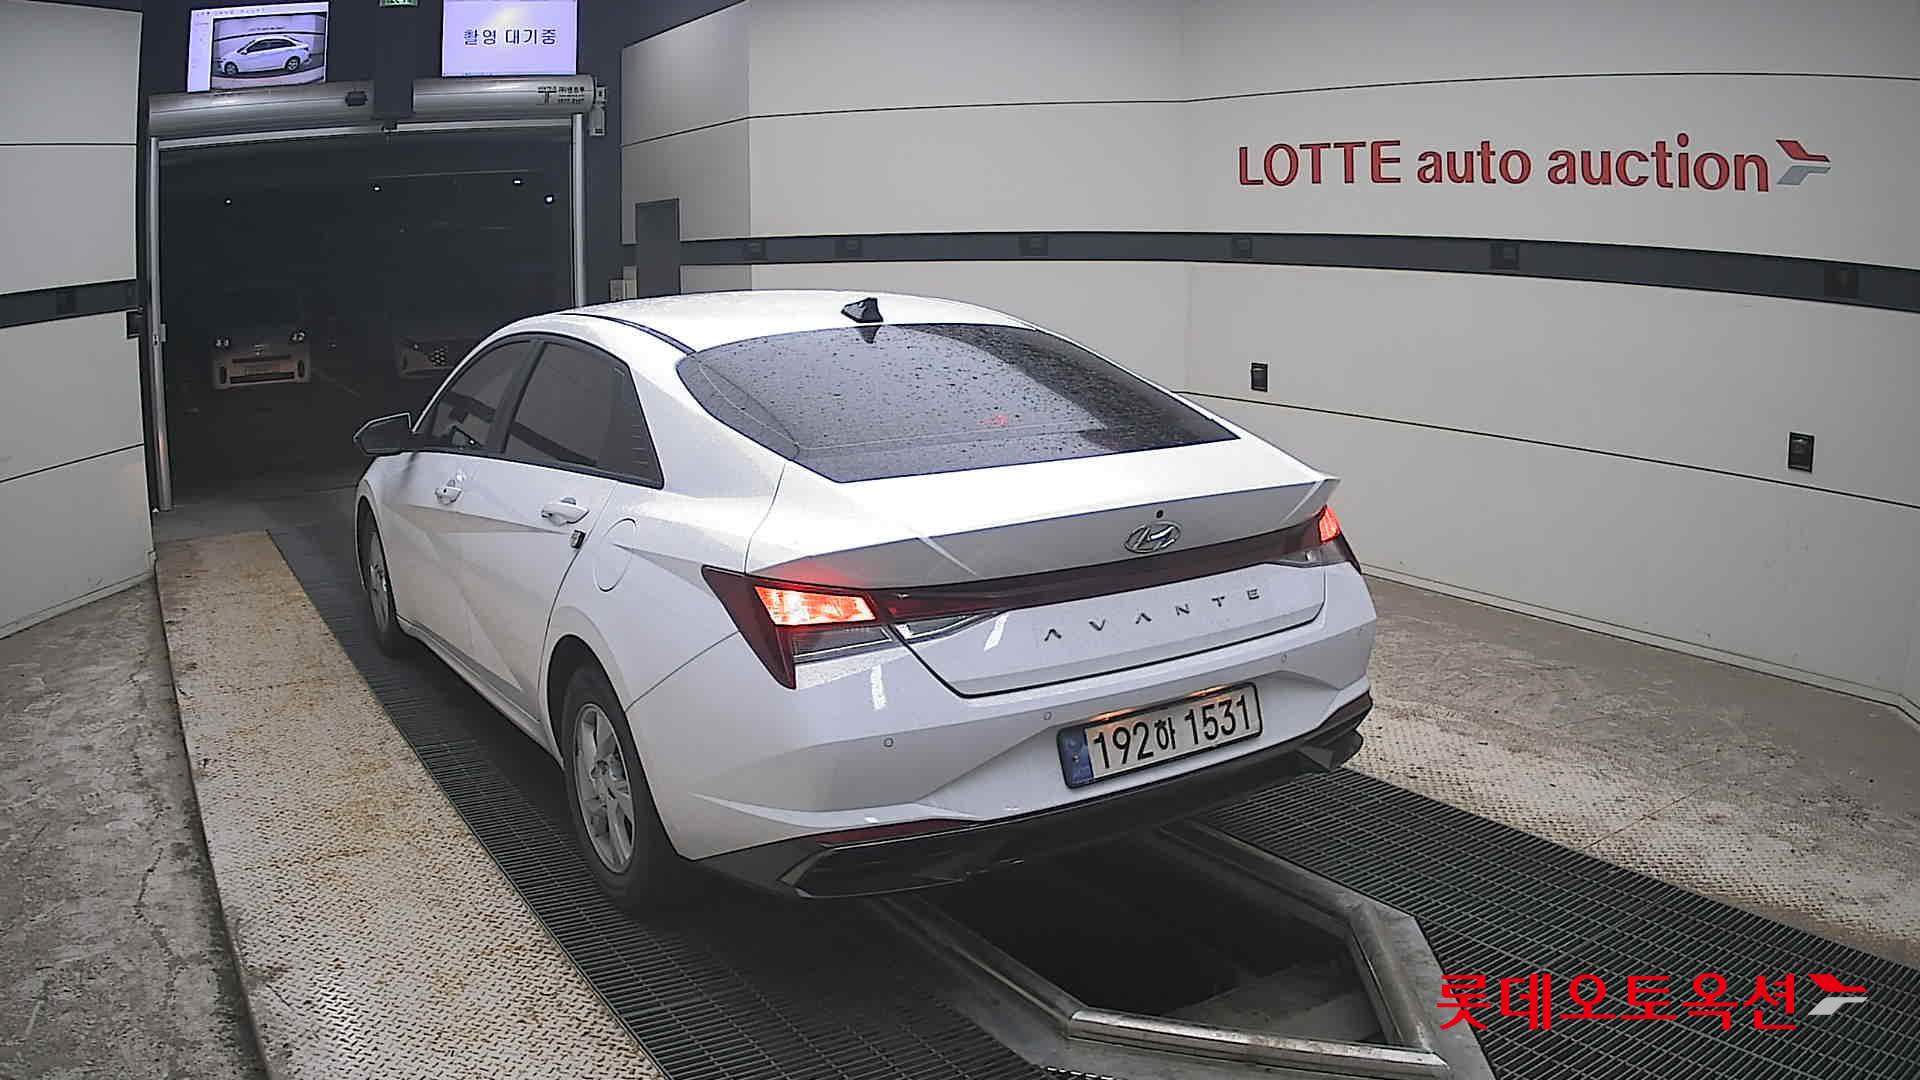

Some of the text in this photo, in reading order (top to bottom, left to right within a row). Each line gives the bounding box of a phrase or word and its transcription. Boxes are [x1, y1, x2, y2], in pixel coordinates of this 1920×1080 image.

[505, 28, 557, 46] 대기중
[1239, 132, 1771, 193] LOTTE auto auction
[1043, 588, 1261, 642] AVANTE
[1091, 694, 1252, 770] 192하 1531
